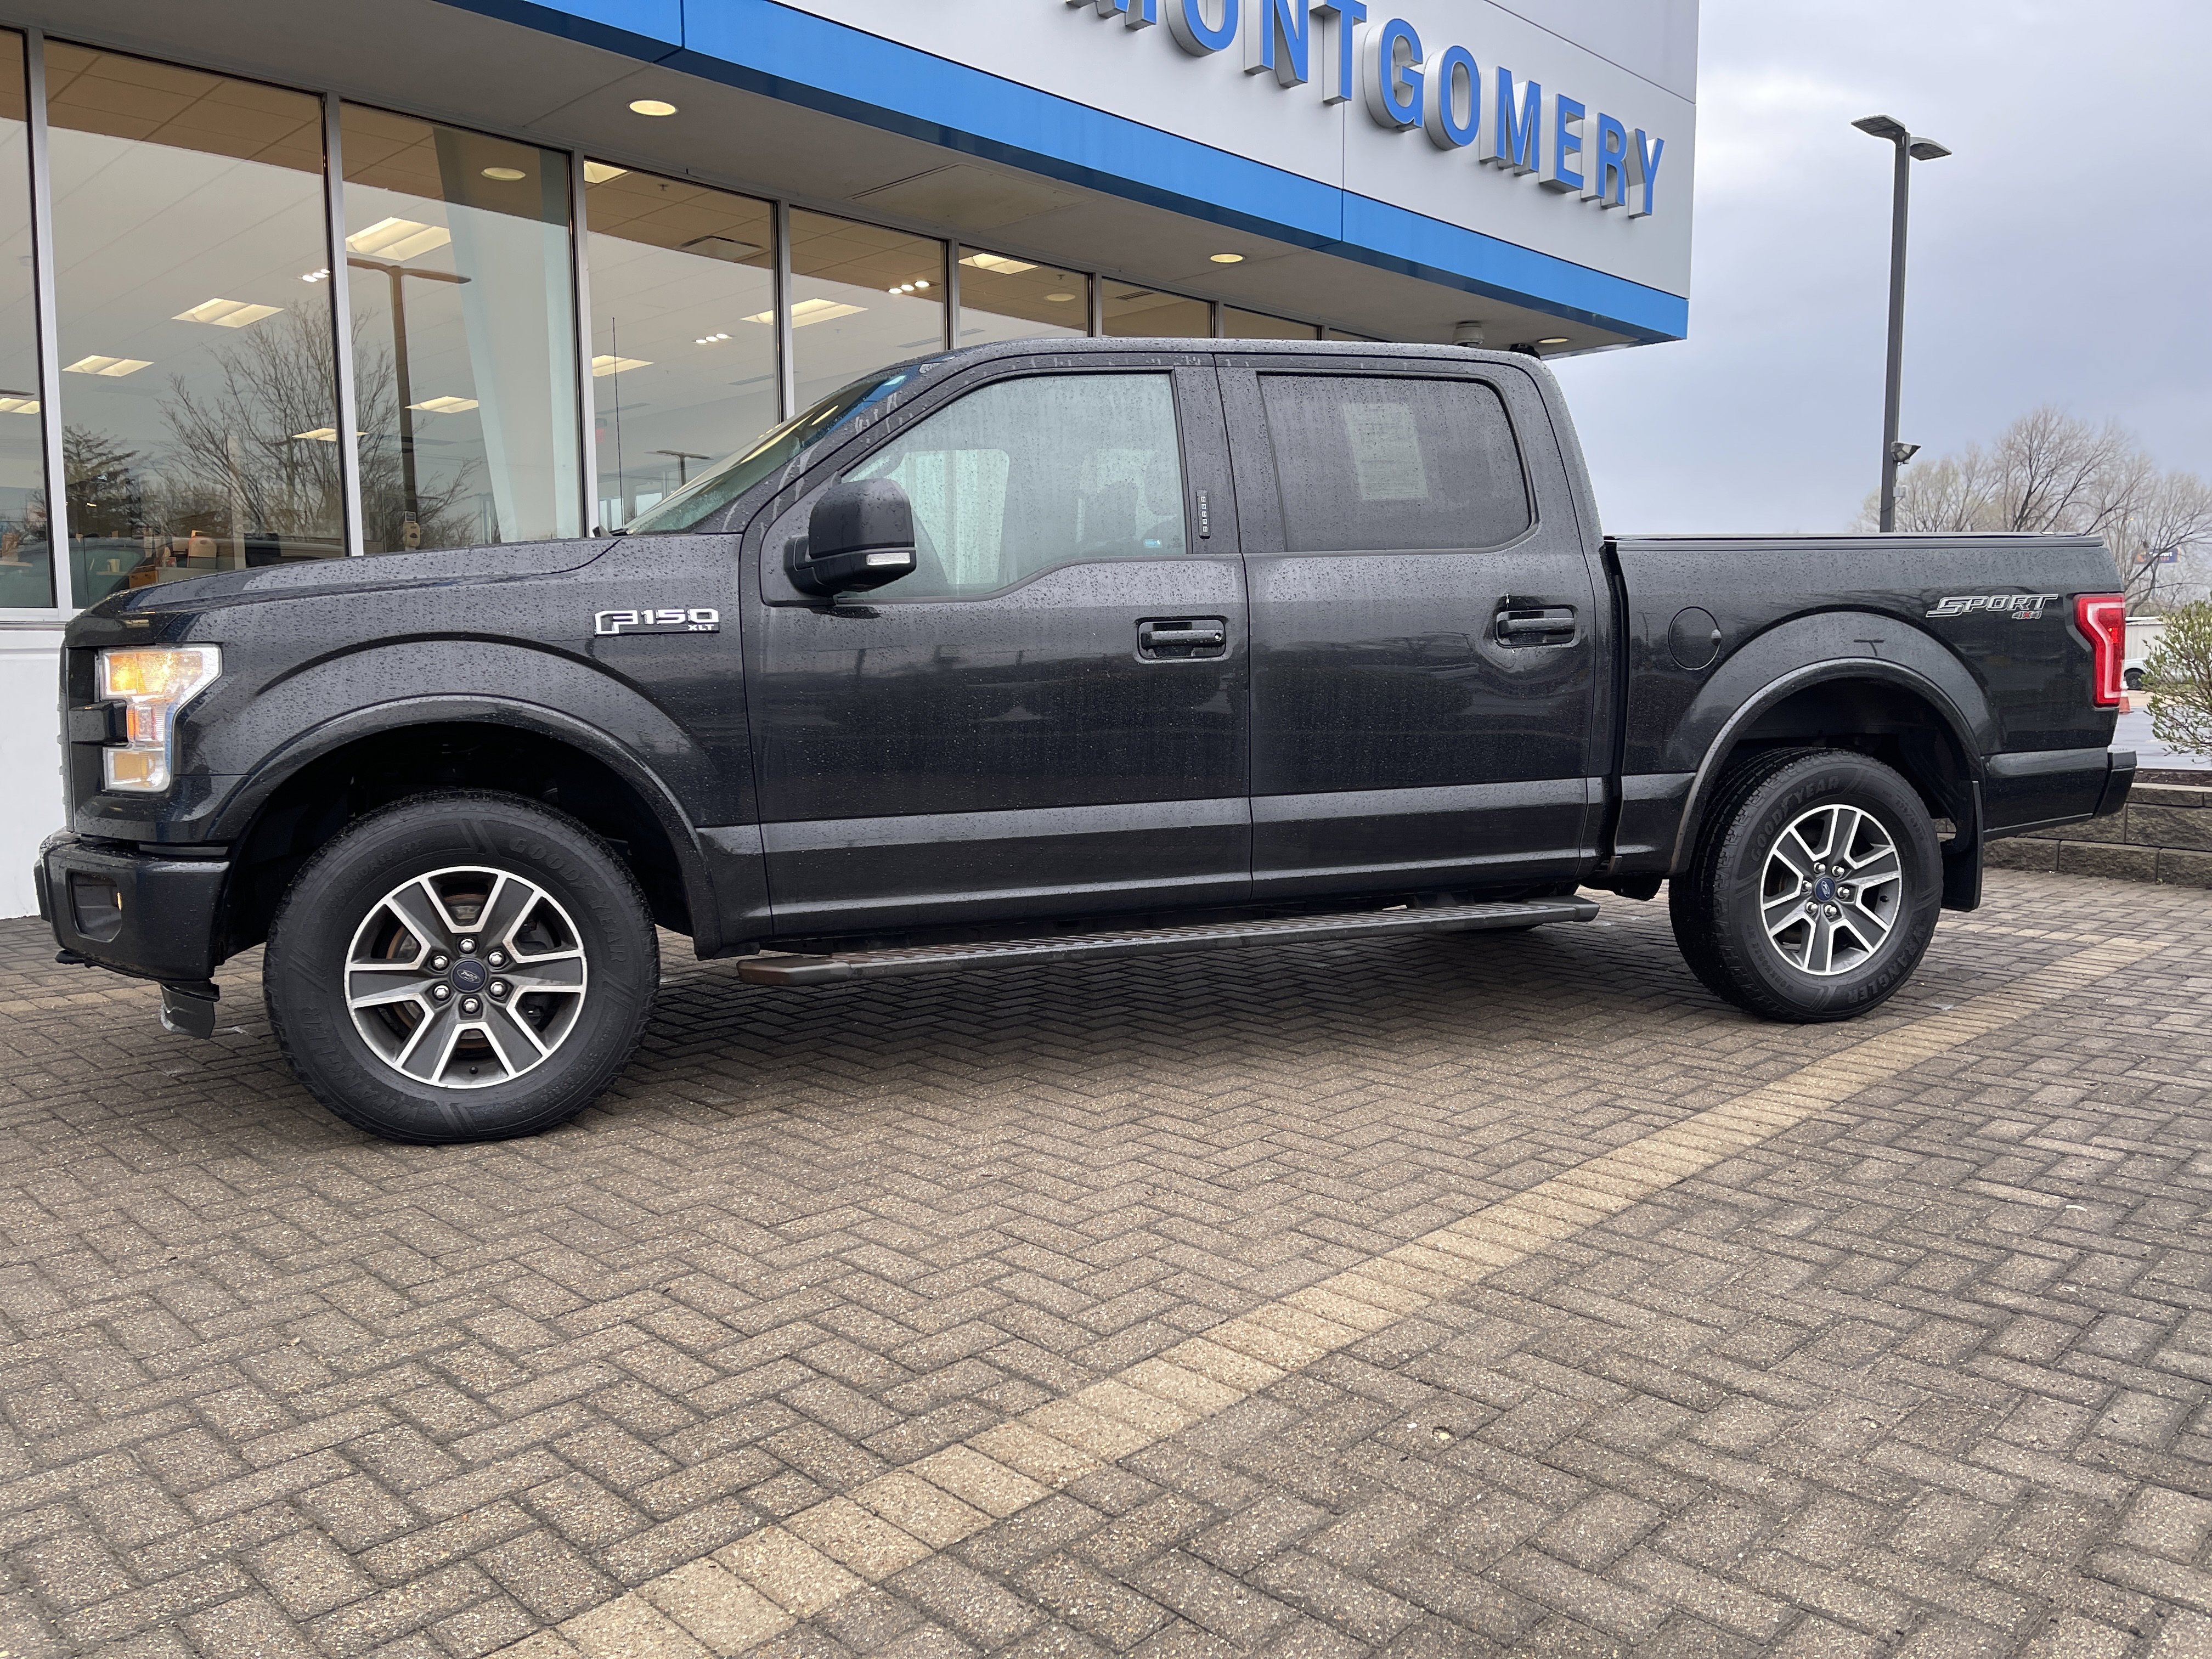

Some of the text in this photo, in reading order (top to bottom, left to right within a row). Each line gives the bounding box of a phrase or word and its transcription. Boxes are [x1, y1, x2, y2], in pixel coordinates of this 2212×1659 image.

[594, 608, 719, 635] F150
[1926, 594, 2058, 617] SPORT
[1848, 922, 1928, 1003] WRANGLER
[302, 1006, 418, 1124] WRANGLER
